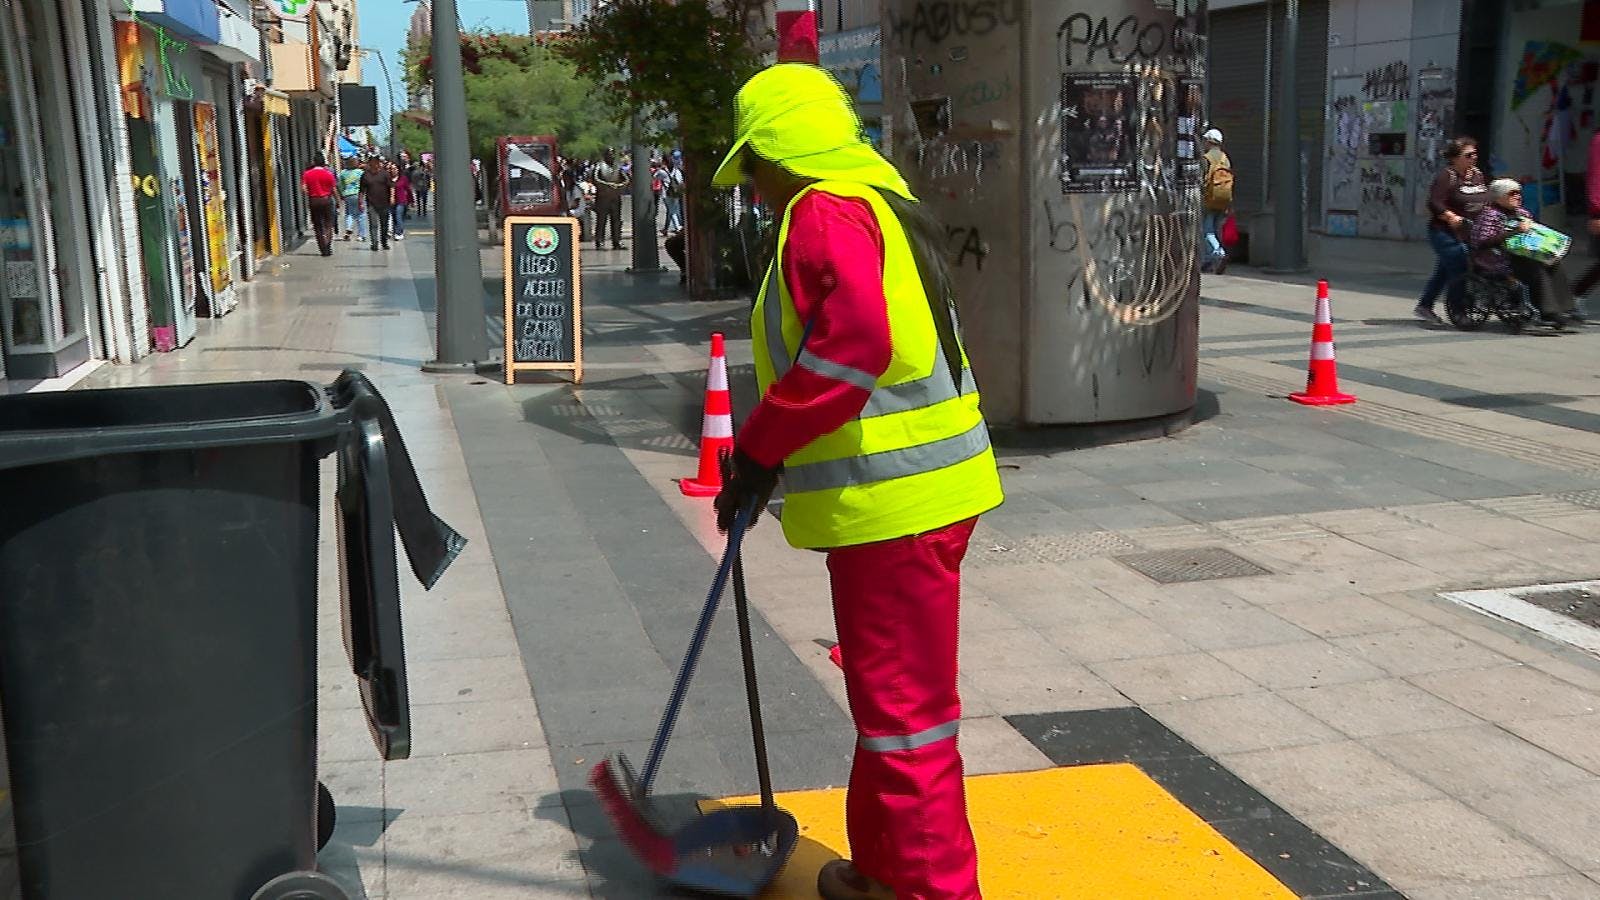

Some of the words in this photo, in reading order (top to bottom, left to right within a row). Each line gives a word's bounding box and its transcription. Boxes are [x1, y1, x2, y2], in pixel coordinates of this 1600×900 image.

[1057, 12, 1165, 66] PACO
[519, 253, 559, 275] LLEGO
[523, 278, 566, 297] ACEITE
[516, 302, 533, 317] DE
[536, 302, 566, 317] COCO
[515, 338, 564, 361] VIRGEN
